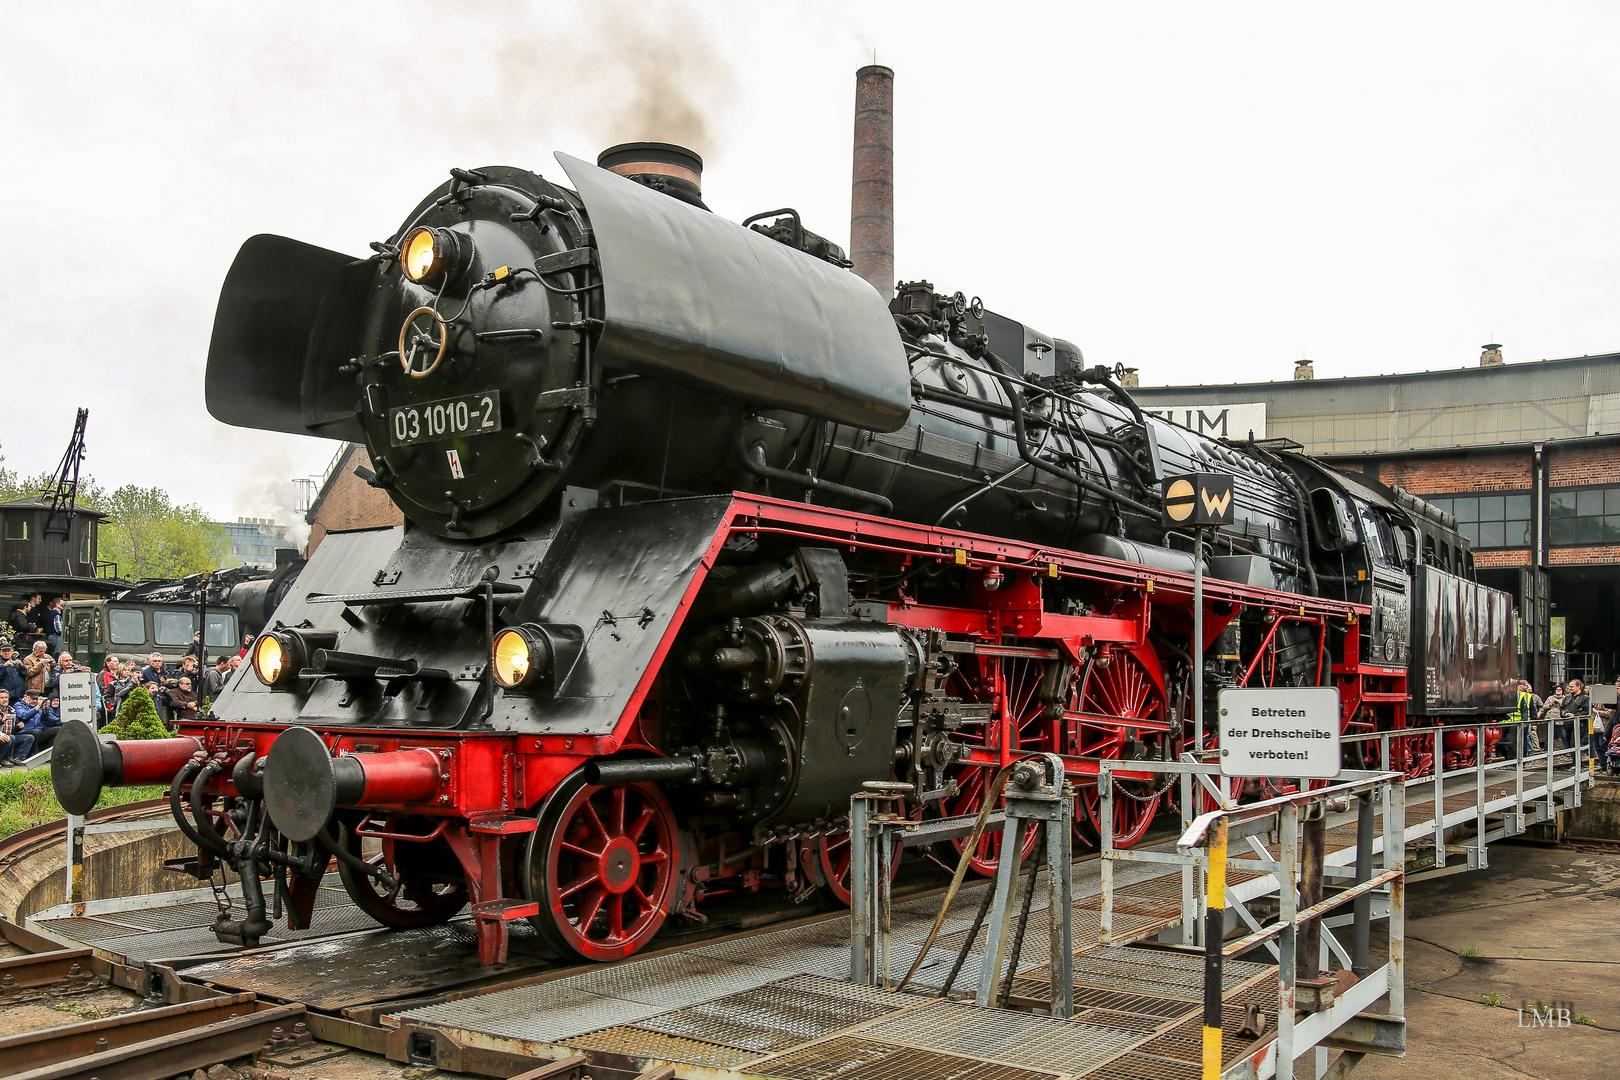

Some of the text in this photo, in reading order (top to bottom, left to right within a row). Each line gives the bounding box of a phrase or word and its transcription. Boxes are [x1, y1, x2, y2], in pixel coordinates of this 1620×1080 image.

[395, 396, 494, 440] 03 1010-2
[1201, 486, 1232, 518] W
[1251, 707, 1306, 717] Betreten
[1228, 728, 1331, 739] der Drehscheibe
[1249, 750, 1309, 760] verboten!
